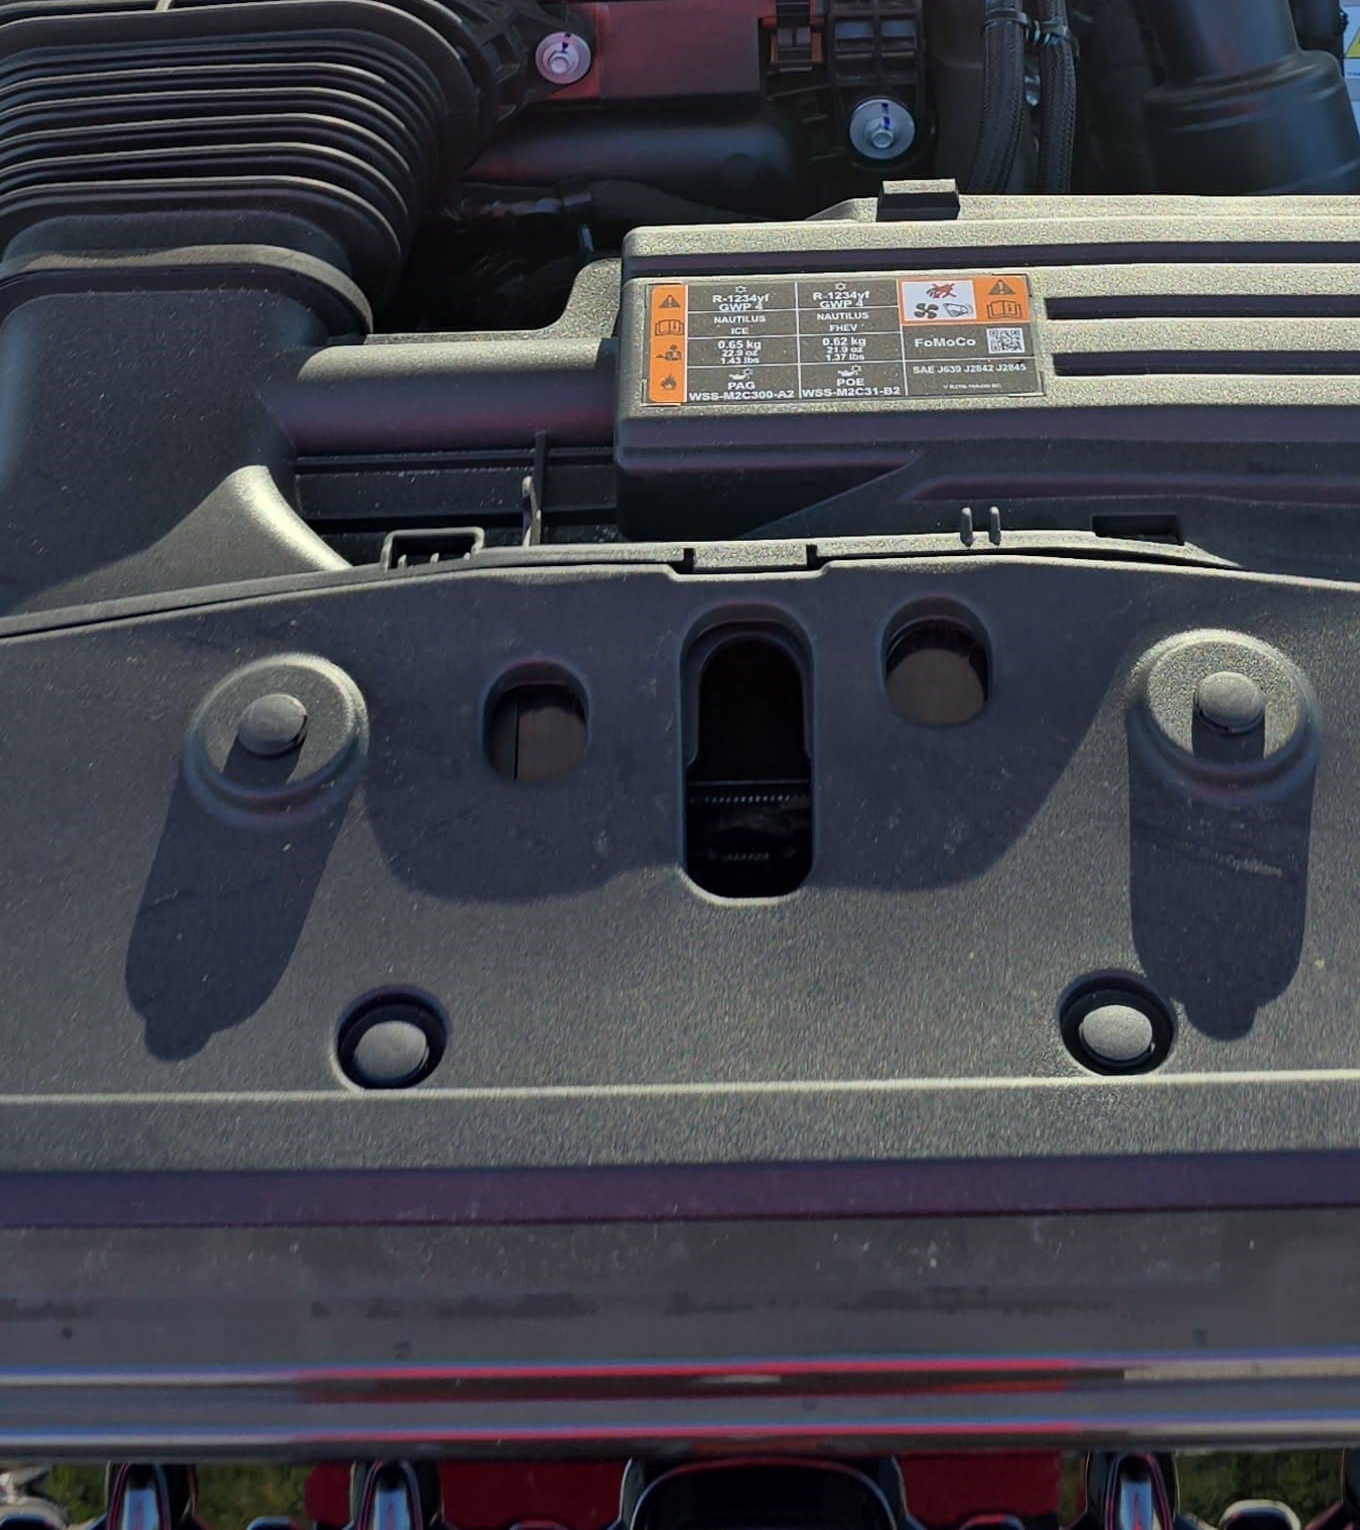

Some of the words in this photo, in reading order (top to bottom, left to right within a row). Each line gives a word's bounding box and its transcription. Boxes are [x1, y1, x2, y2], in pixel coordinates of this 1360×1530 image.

[712, 293, 771, 303] R-1234yf
[812, 290, 871, 301] R-1234yf
[718, 302, 752, 311] GWP
[754, 302, 764, 310] 4
[819, 300, 853, 308] GWP
[855, 300, 864, 308] 4
[713, 314, 767, 324] NAUTILUS
[816, 311, 870, 321] NAUTILUS
[730, 326, 750, 335] ICE
[829, 323, 858, 332] FHEV
[717, 340, 744, 350] 0.65
[746, 339, 762, 351] kg
[822, 337, 849, 347] 0.62
[851, 336, 867, 348] kg
[914, 336, 976, 348] FoMoCo
[721, 349, 744, 358] 22.9
[745, 349, 759, 357] oz
[850, 346, 864, 354] oz
[720, 357, 743, 365] 1.43
[912, 364, 935, 375] SAE
[727, 381, 756, 390] PAG
[836, 378, 865, 387] POE
[688, 389, 796, 402] WSS-M2C300-A2
[801, 386, 902, 398] WSS-M2C31-B2
